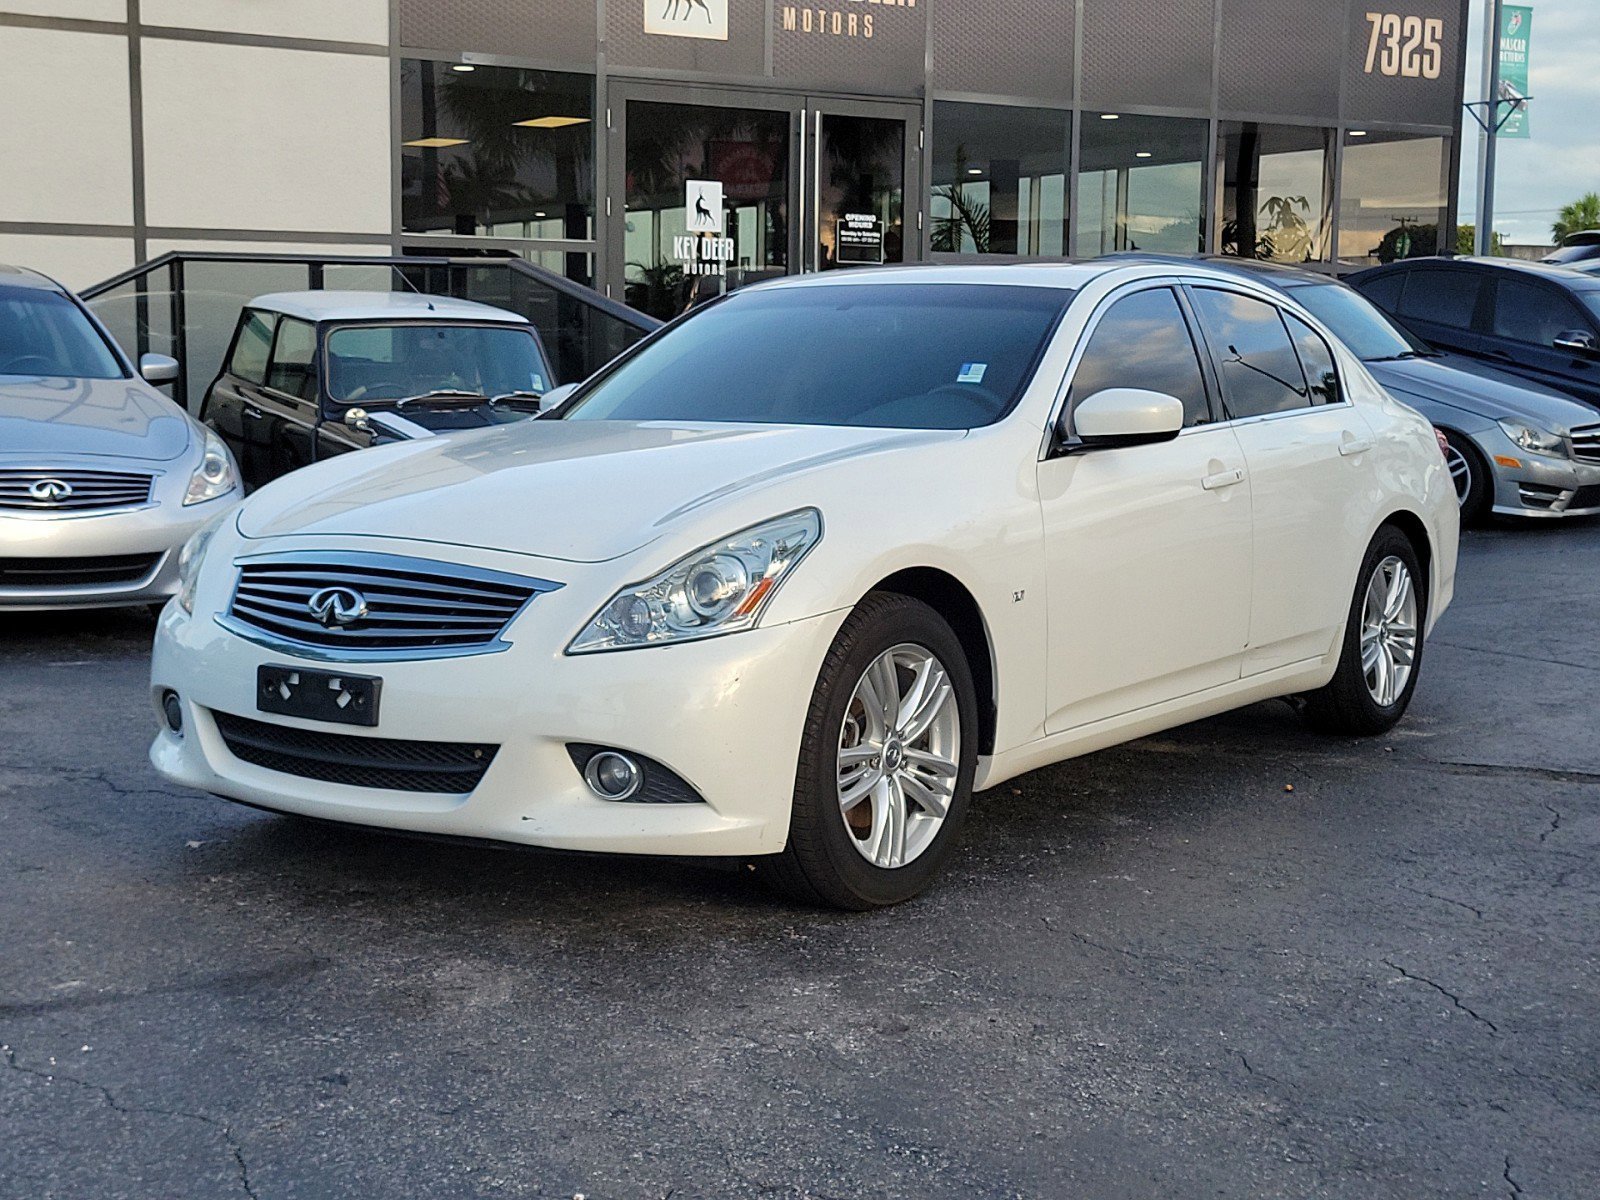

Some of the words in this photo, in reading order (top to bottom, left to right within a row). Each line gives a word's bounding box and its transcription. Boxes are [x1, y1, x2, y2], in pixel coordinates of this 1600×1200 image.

[783, 6, 874, 38] MOTORS
[1364, 12, 1443, 79] 7325
[1500, 37, 1526, 52] NASCAR
[845, 213, 876, 222] OPENING
[674, 236, 699, 260] KEY
[701, 236, 734, 261] DEER
[683, 262, 725, 276] MOTORS
